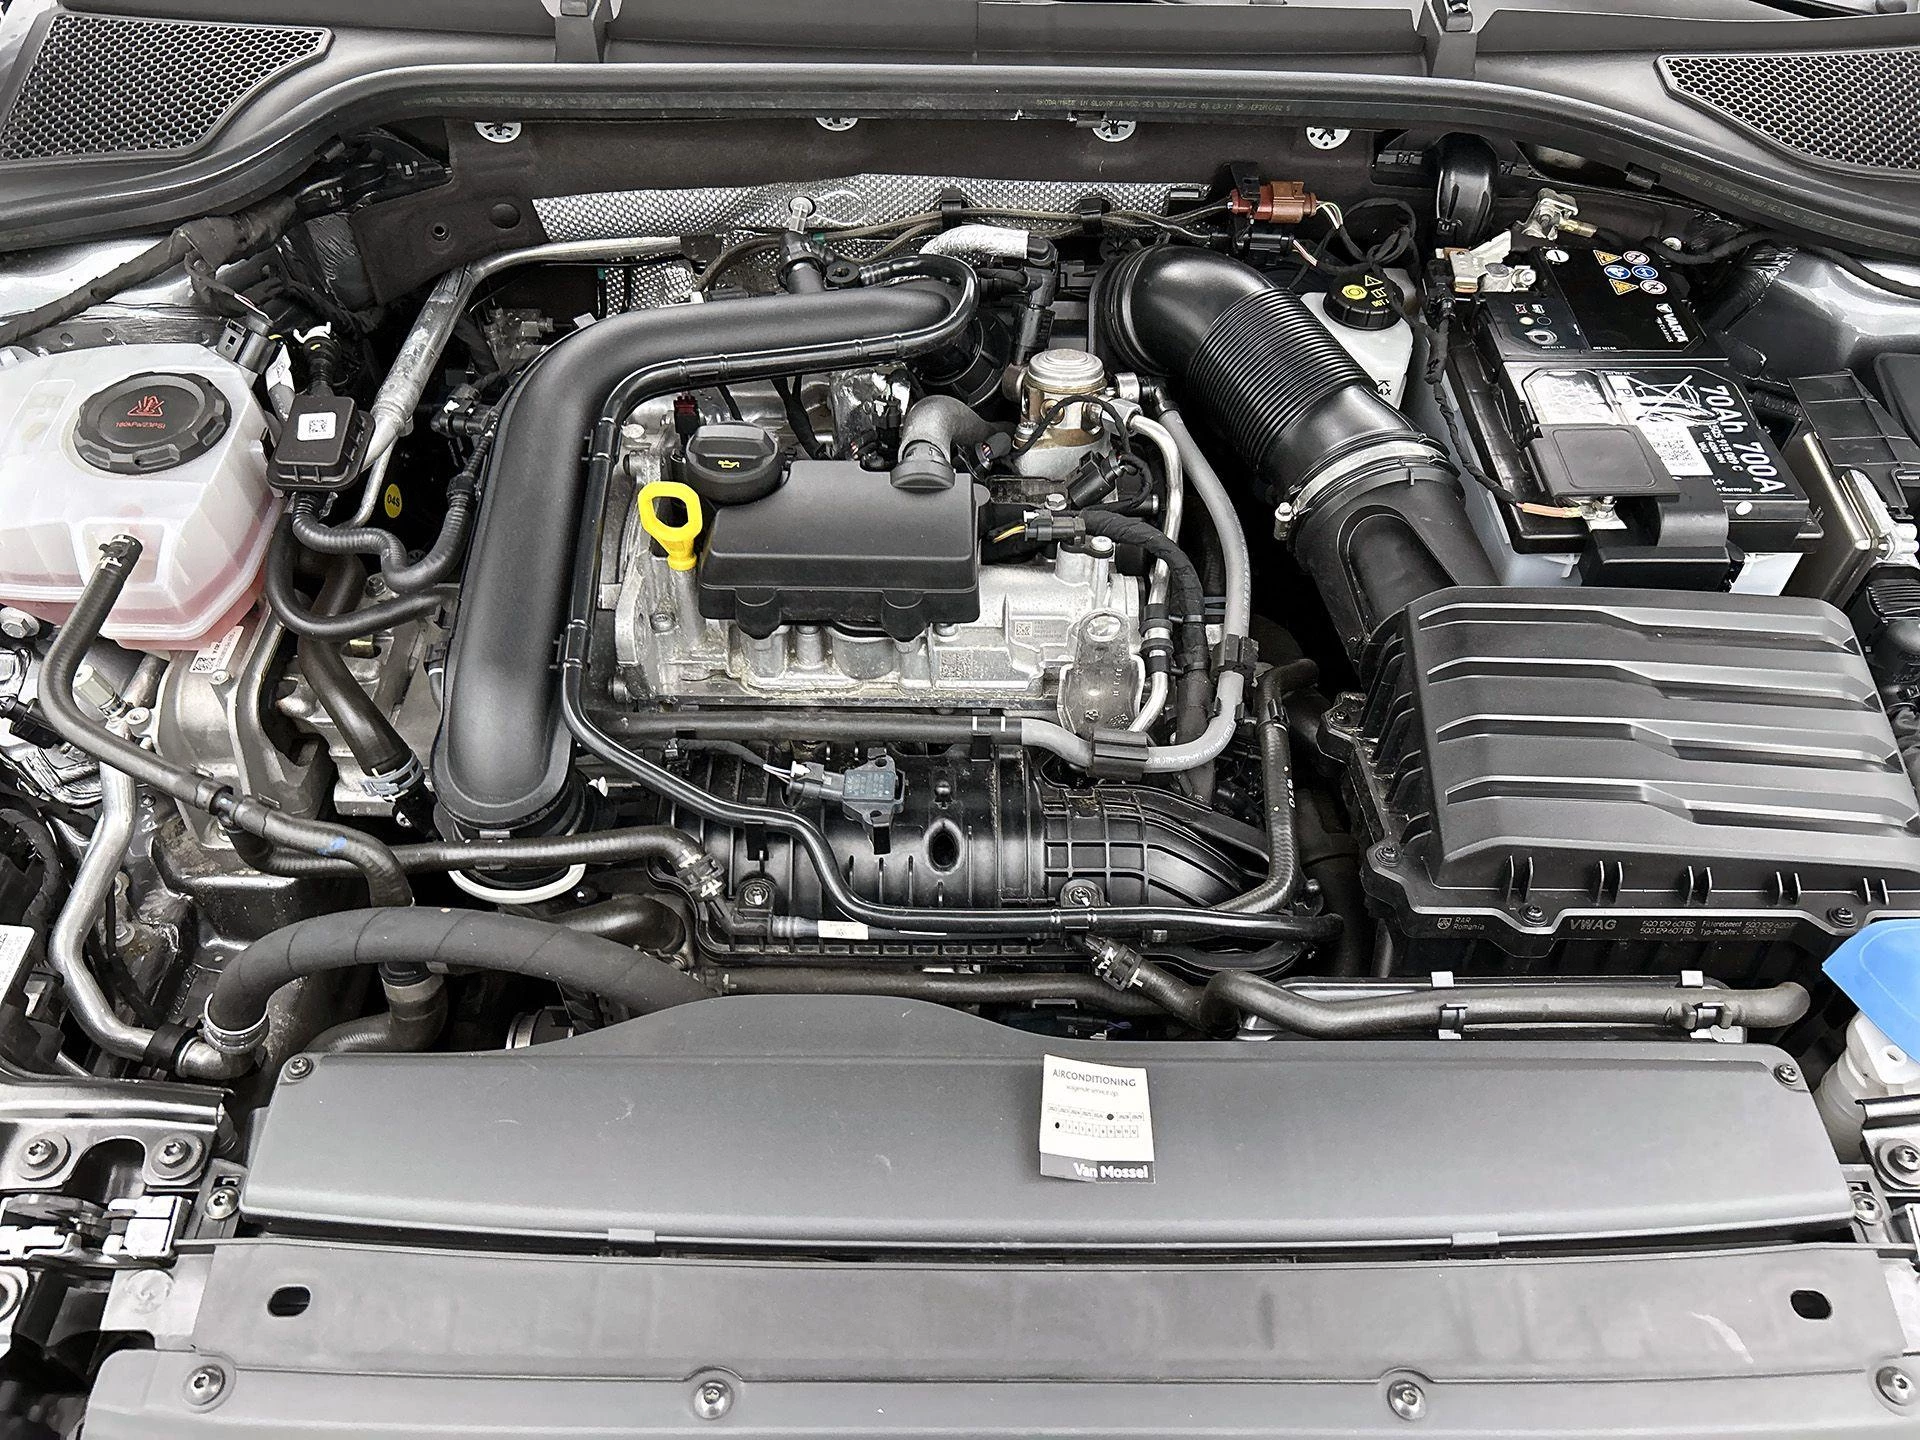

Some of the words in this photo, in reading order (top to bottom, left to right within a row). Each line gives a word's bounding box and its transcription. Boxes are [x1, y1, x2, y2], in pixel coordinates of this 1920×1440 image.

[1664, 312, 1689, 343] VARTA
[1699, 385, 1748, 434] 70Ah
[1733, 441, 1787, 493] 700A
[1452, 923, 1485, 931] Romania
[1569, 919, 1618, 930] VWAG
[1053, 1068, 1136, 1087] AIRCONDITIONING
[1073, 1162, 1098, 1178] Van
[1100, 1164, 1149, 1179] Mossel
